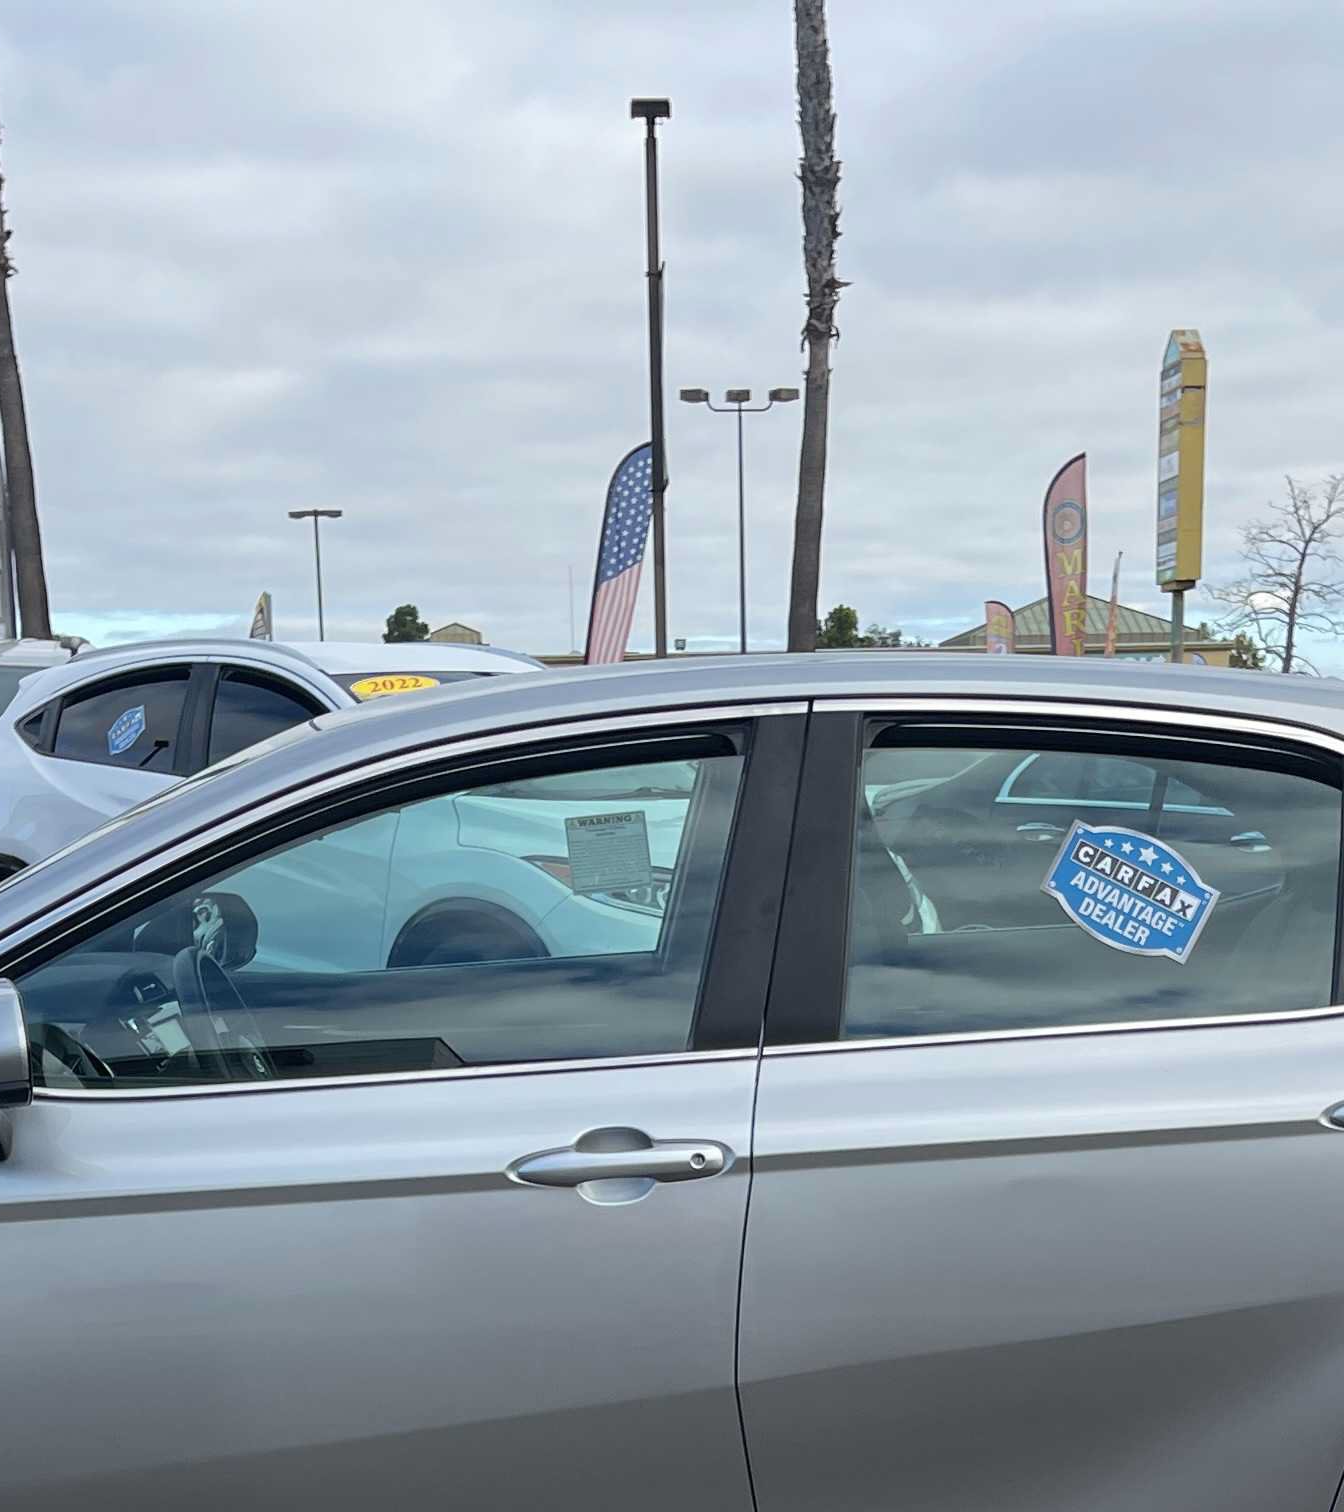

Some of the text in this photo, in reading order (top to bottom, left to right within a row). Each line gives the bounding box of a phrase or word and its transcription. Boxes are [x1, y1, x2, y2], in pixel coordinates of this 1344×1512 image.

[368, 677, 423, 693] 2022
[576, 814, 633, 828] WARNING
[1070, 871, 1179, 936] ADVANTAGE
[1074, 843, 1197, 919] CARFAX
[1078, 897, 1151, 946] DEALER
